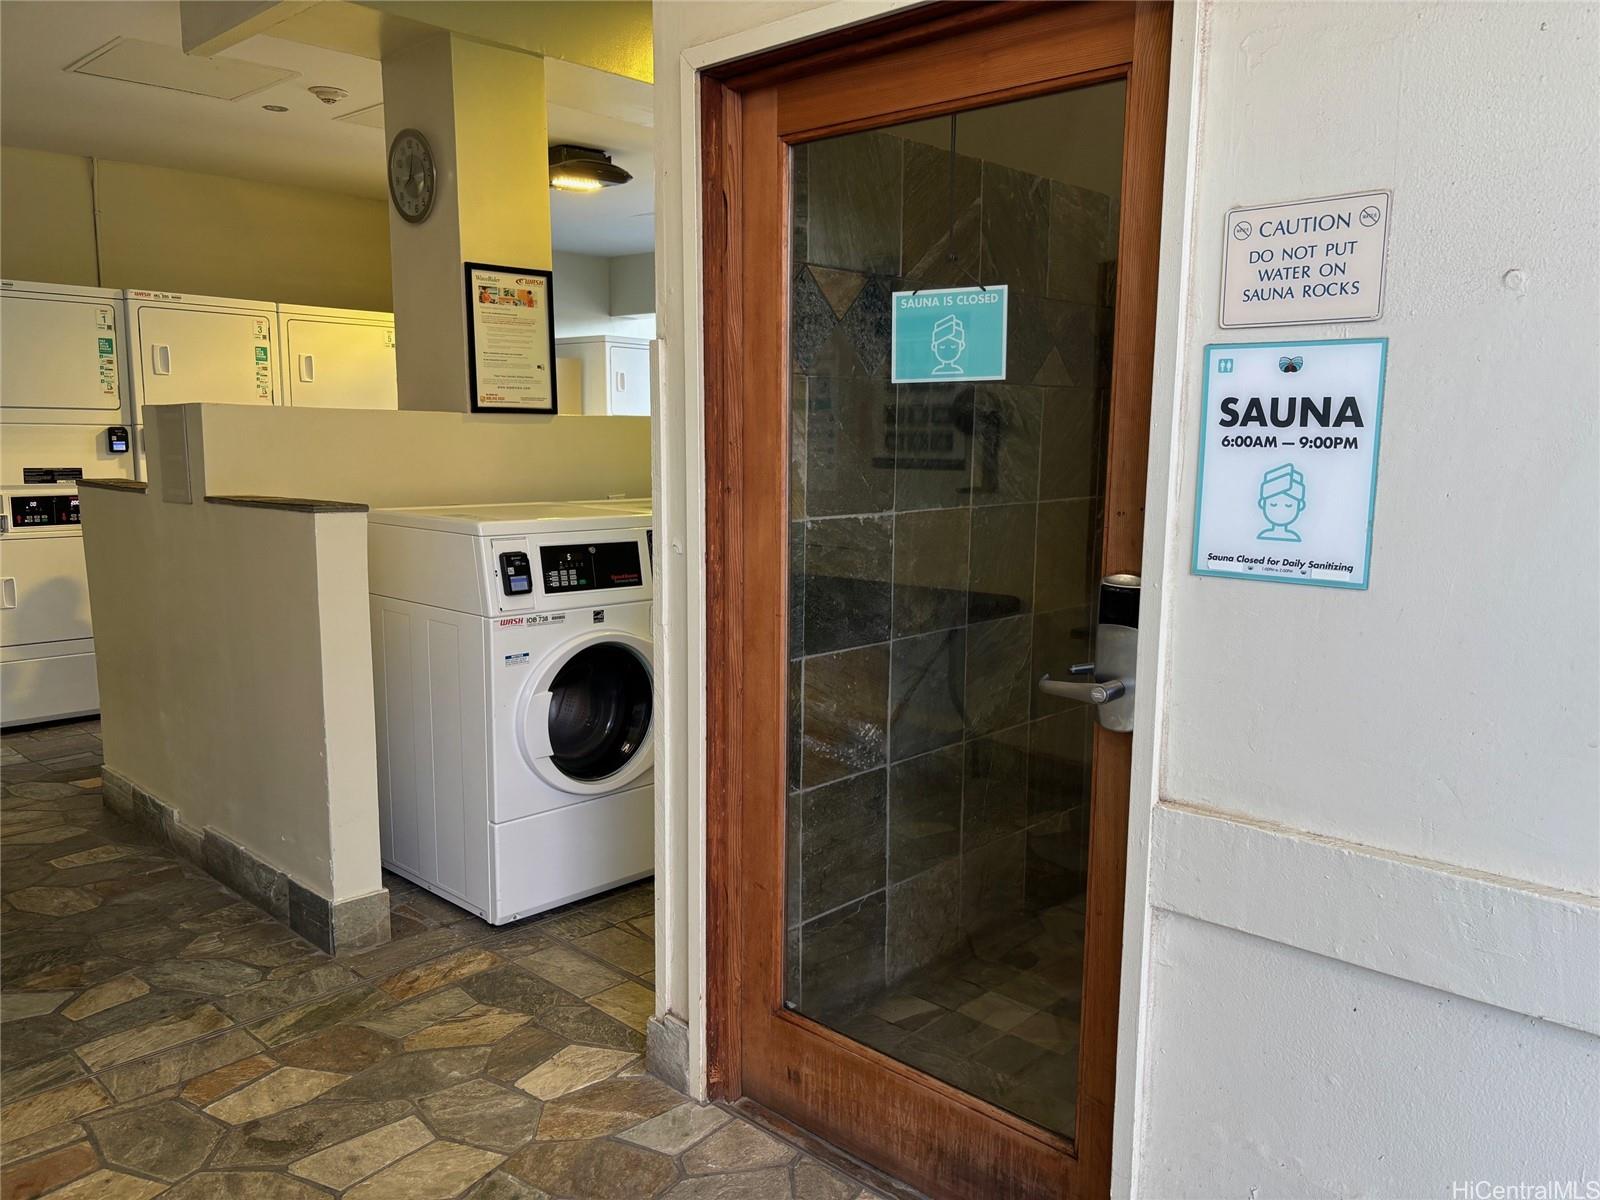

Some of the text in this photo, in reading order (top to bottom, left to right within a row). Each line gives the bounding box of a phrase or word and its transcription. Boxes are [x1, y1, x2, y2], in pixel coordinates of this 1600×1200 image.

[1259, 212, 1352, 238] CAUTION
[1249, 240, 1358, 264] DO NOT PUT
[1258, 262, 1346, 282] WATER ON
[900, 293, 999, 309] SAUNA IS CLOSED
[1242, 281, 1360, 302] SAUNA ROCKS
[1218, 397, 1364, 428] SAUNA
[1221, 436, 1278, 448] 6:00AM
[1299, 436, 1358, 449] 9:00PM
[1208, 552, 1354, 573] Sauna Closed for Daily Sanitizing
[500, 617, 524, 626] WASH
